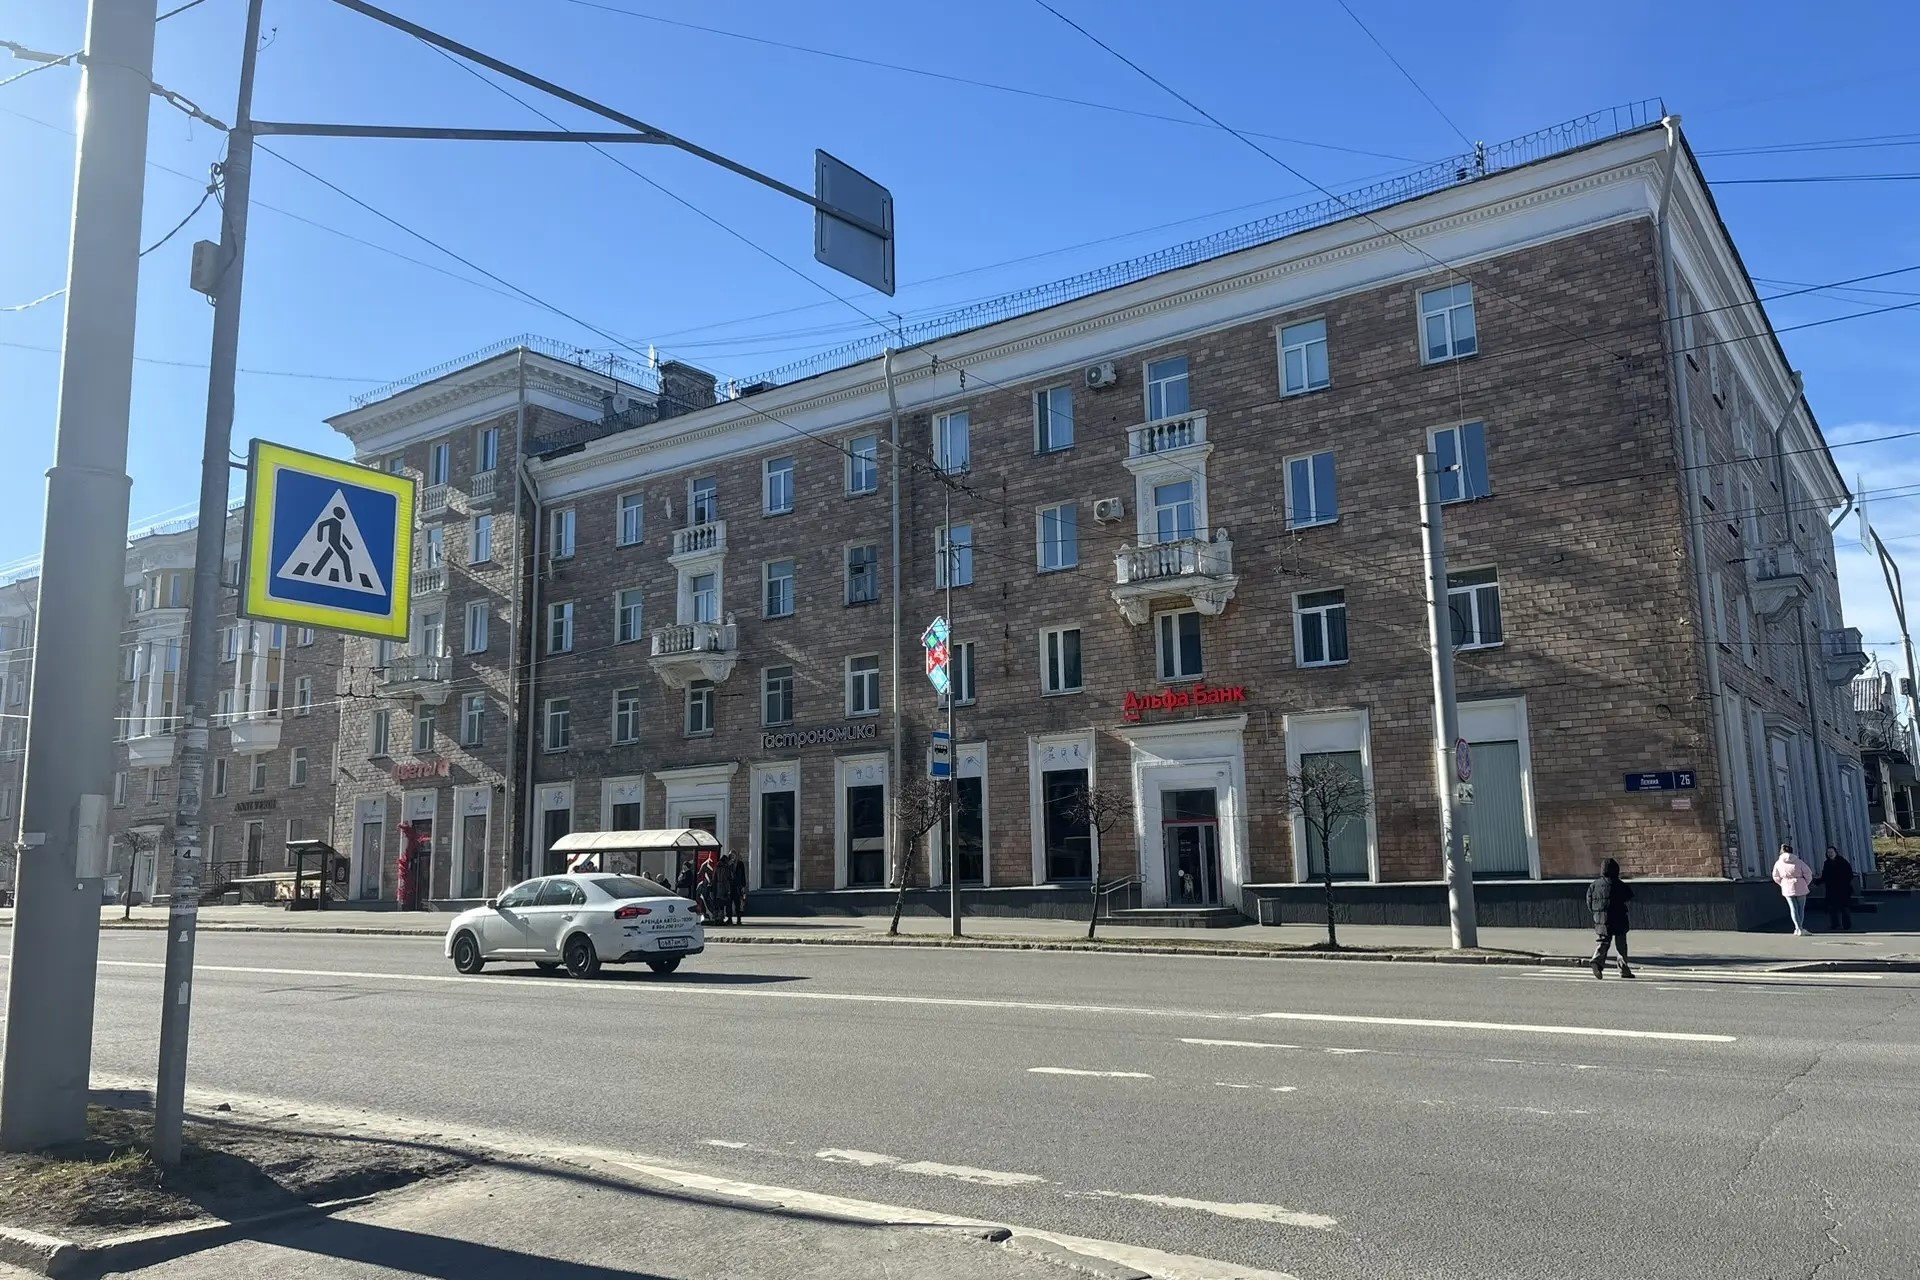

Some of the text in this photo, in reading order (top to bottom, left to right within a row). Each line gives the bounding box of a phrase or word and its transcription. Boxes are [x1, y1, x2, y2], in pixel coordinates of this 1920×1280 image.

[1123, 682, 1247, 719] Альфа Банк
[760, 723, 877, 748] Гастрономика
[1679, 774, 1691, 786] 26
